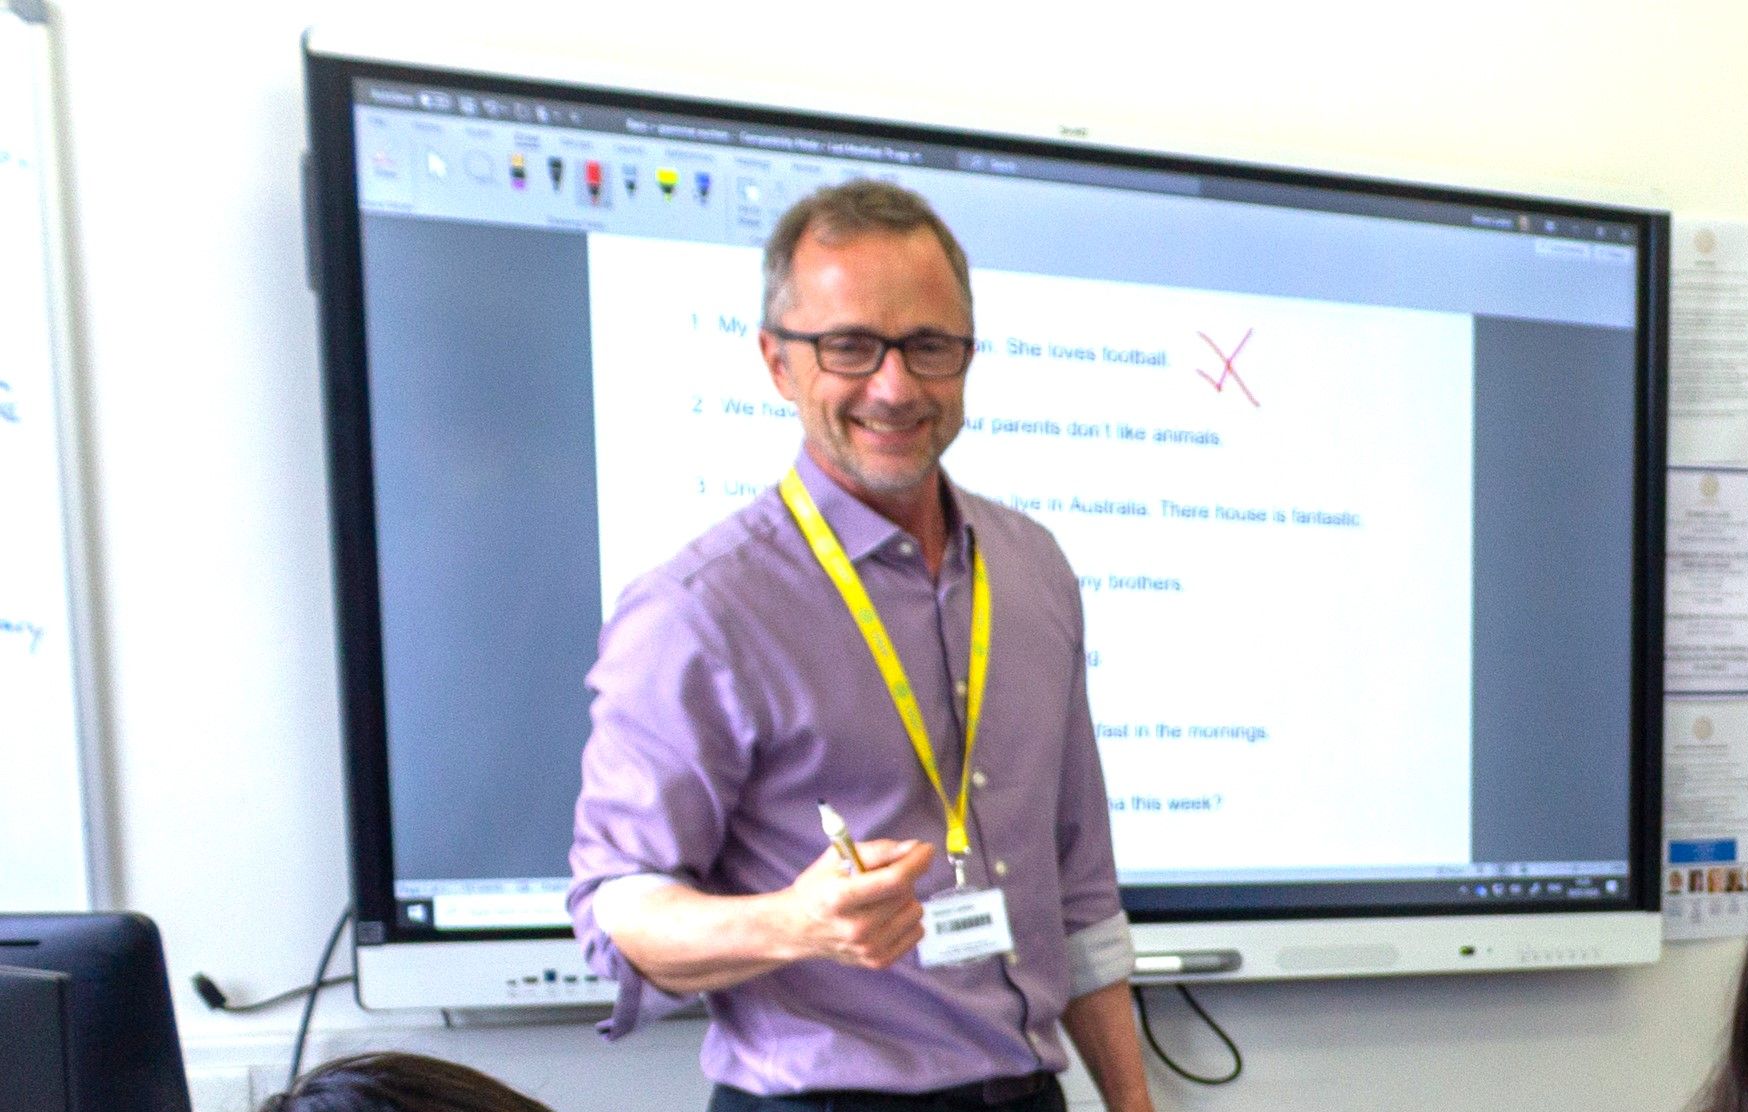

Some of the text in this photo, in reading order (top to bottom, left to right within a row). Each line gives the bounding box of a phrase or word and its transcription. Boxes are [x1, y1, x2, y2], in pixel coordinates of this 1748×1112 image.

[719, 315, 747, 338] My
[1006, 338, 1042, 358] She
[1048, 341, 1097, 362] loves
[725, 398, 755, 415] We
[991, 418, 1060, 437] parents
[1116, 423, 1146, 442] like
[1047, 496, 1064, 513] in
[1160, 499, 1209, 520] There
[1215, 503, 1268, 522] house
[1272, 508, 1286, 523] is
[1134, 723, 1149, 738] in
[1156, 723, 1182, 738] the
[1131, 794, 1161, 811] this
